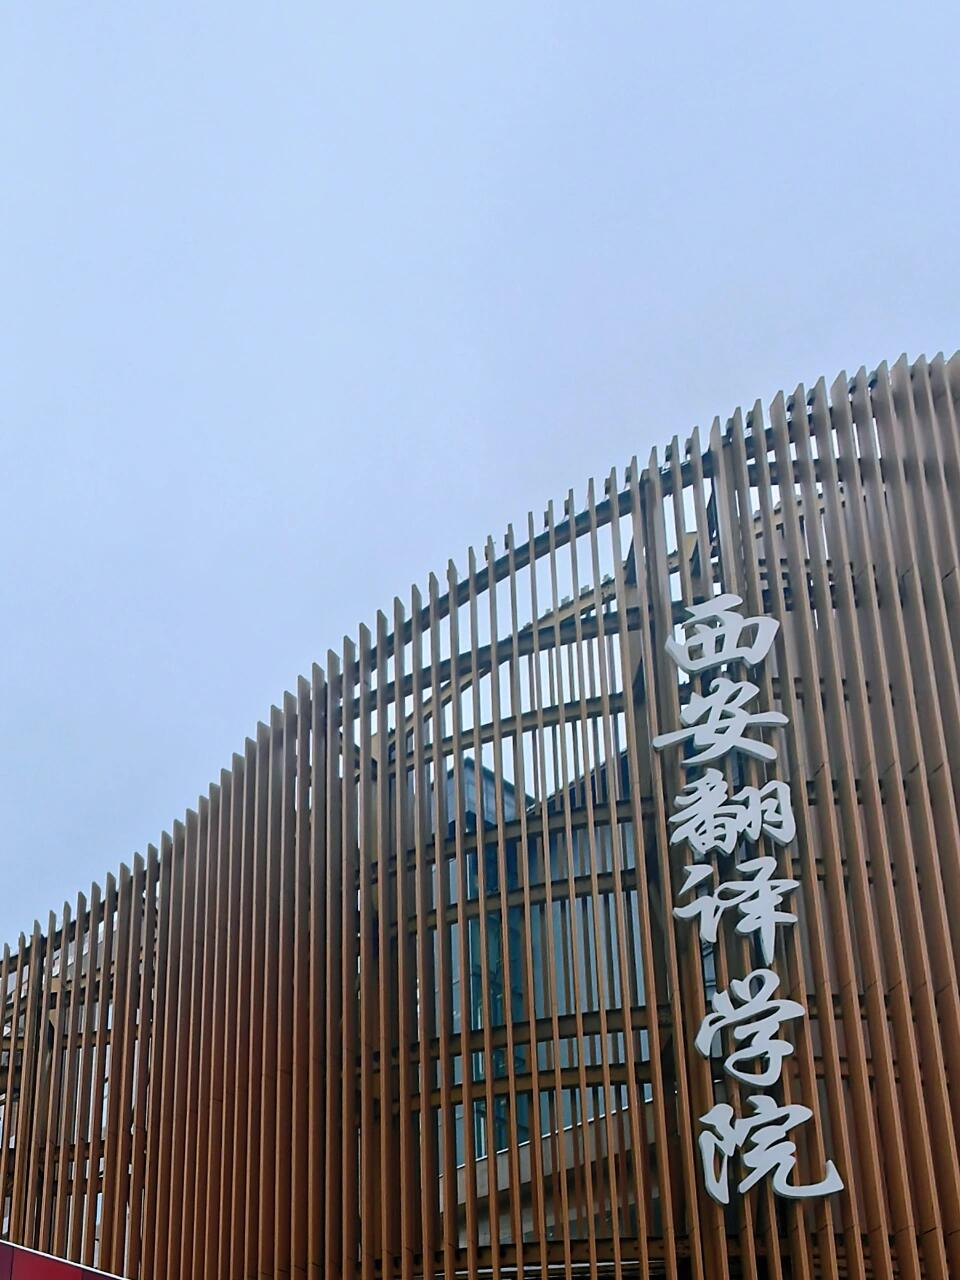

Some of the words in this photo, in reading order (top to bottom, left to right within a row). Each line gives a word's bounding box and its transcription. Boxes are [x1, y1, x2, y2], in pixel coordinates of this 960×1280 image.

[652, 593, 844, 1205] 西安翻译学院
